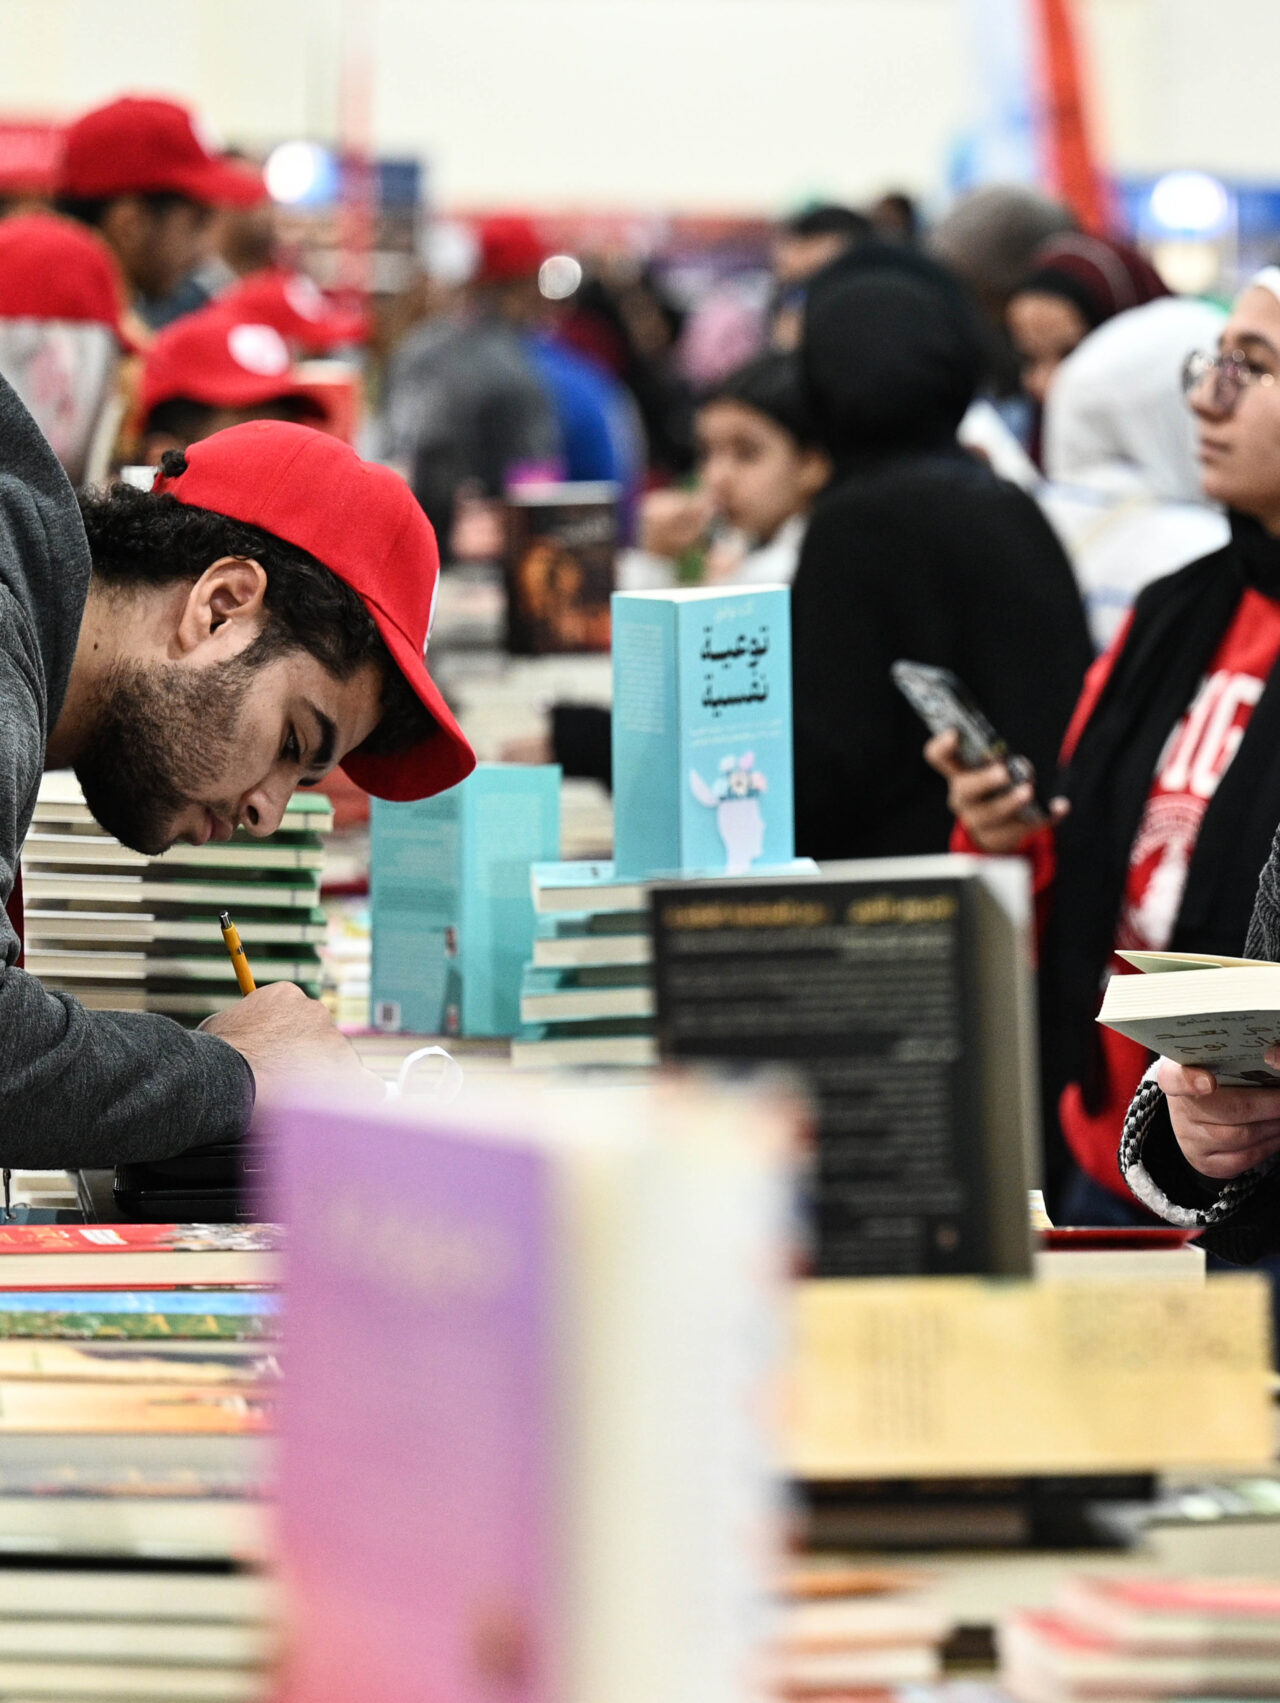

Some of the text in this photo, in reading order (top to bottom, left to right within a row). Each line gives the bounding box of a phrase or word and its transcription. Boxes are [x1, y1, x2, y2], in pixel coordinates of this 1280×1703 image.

[701, 672, 769, 718] نفسية
[1155, 1028, 1230, 1041] بعد
[1174, 1041, 1229, 1055] نوح
